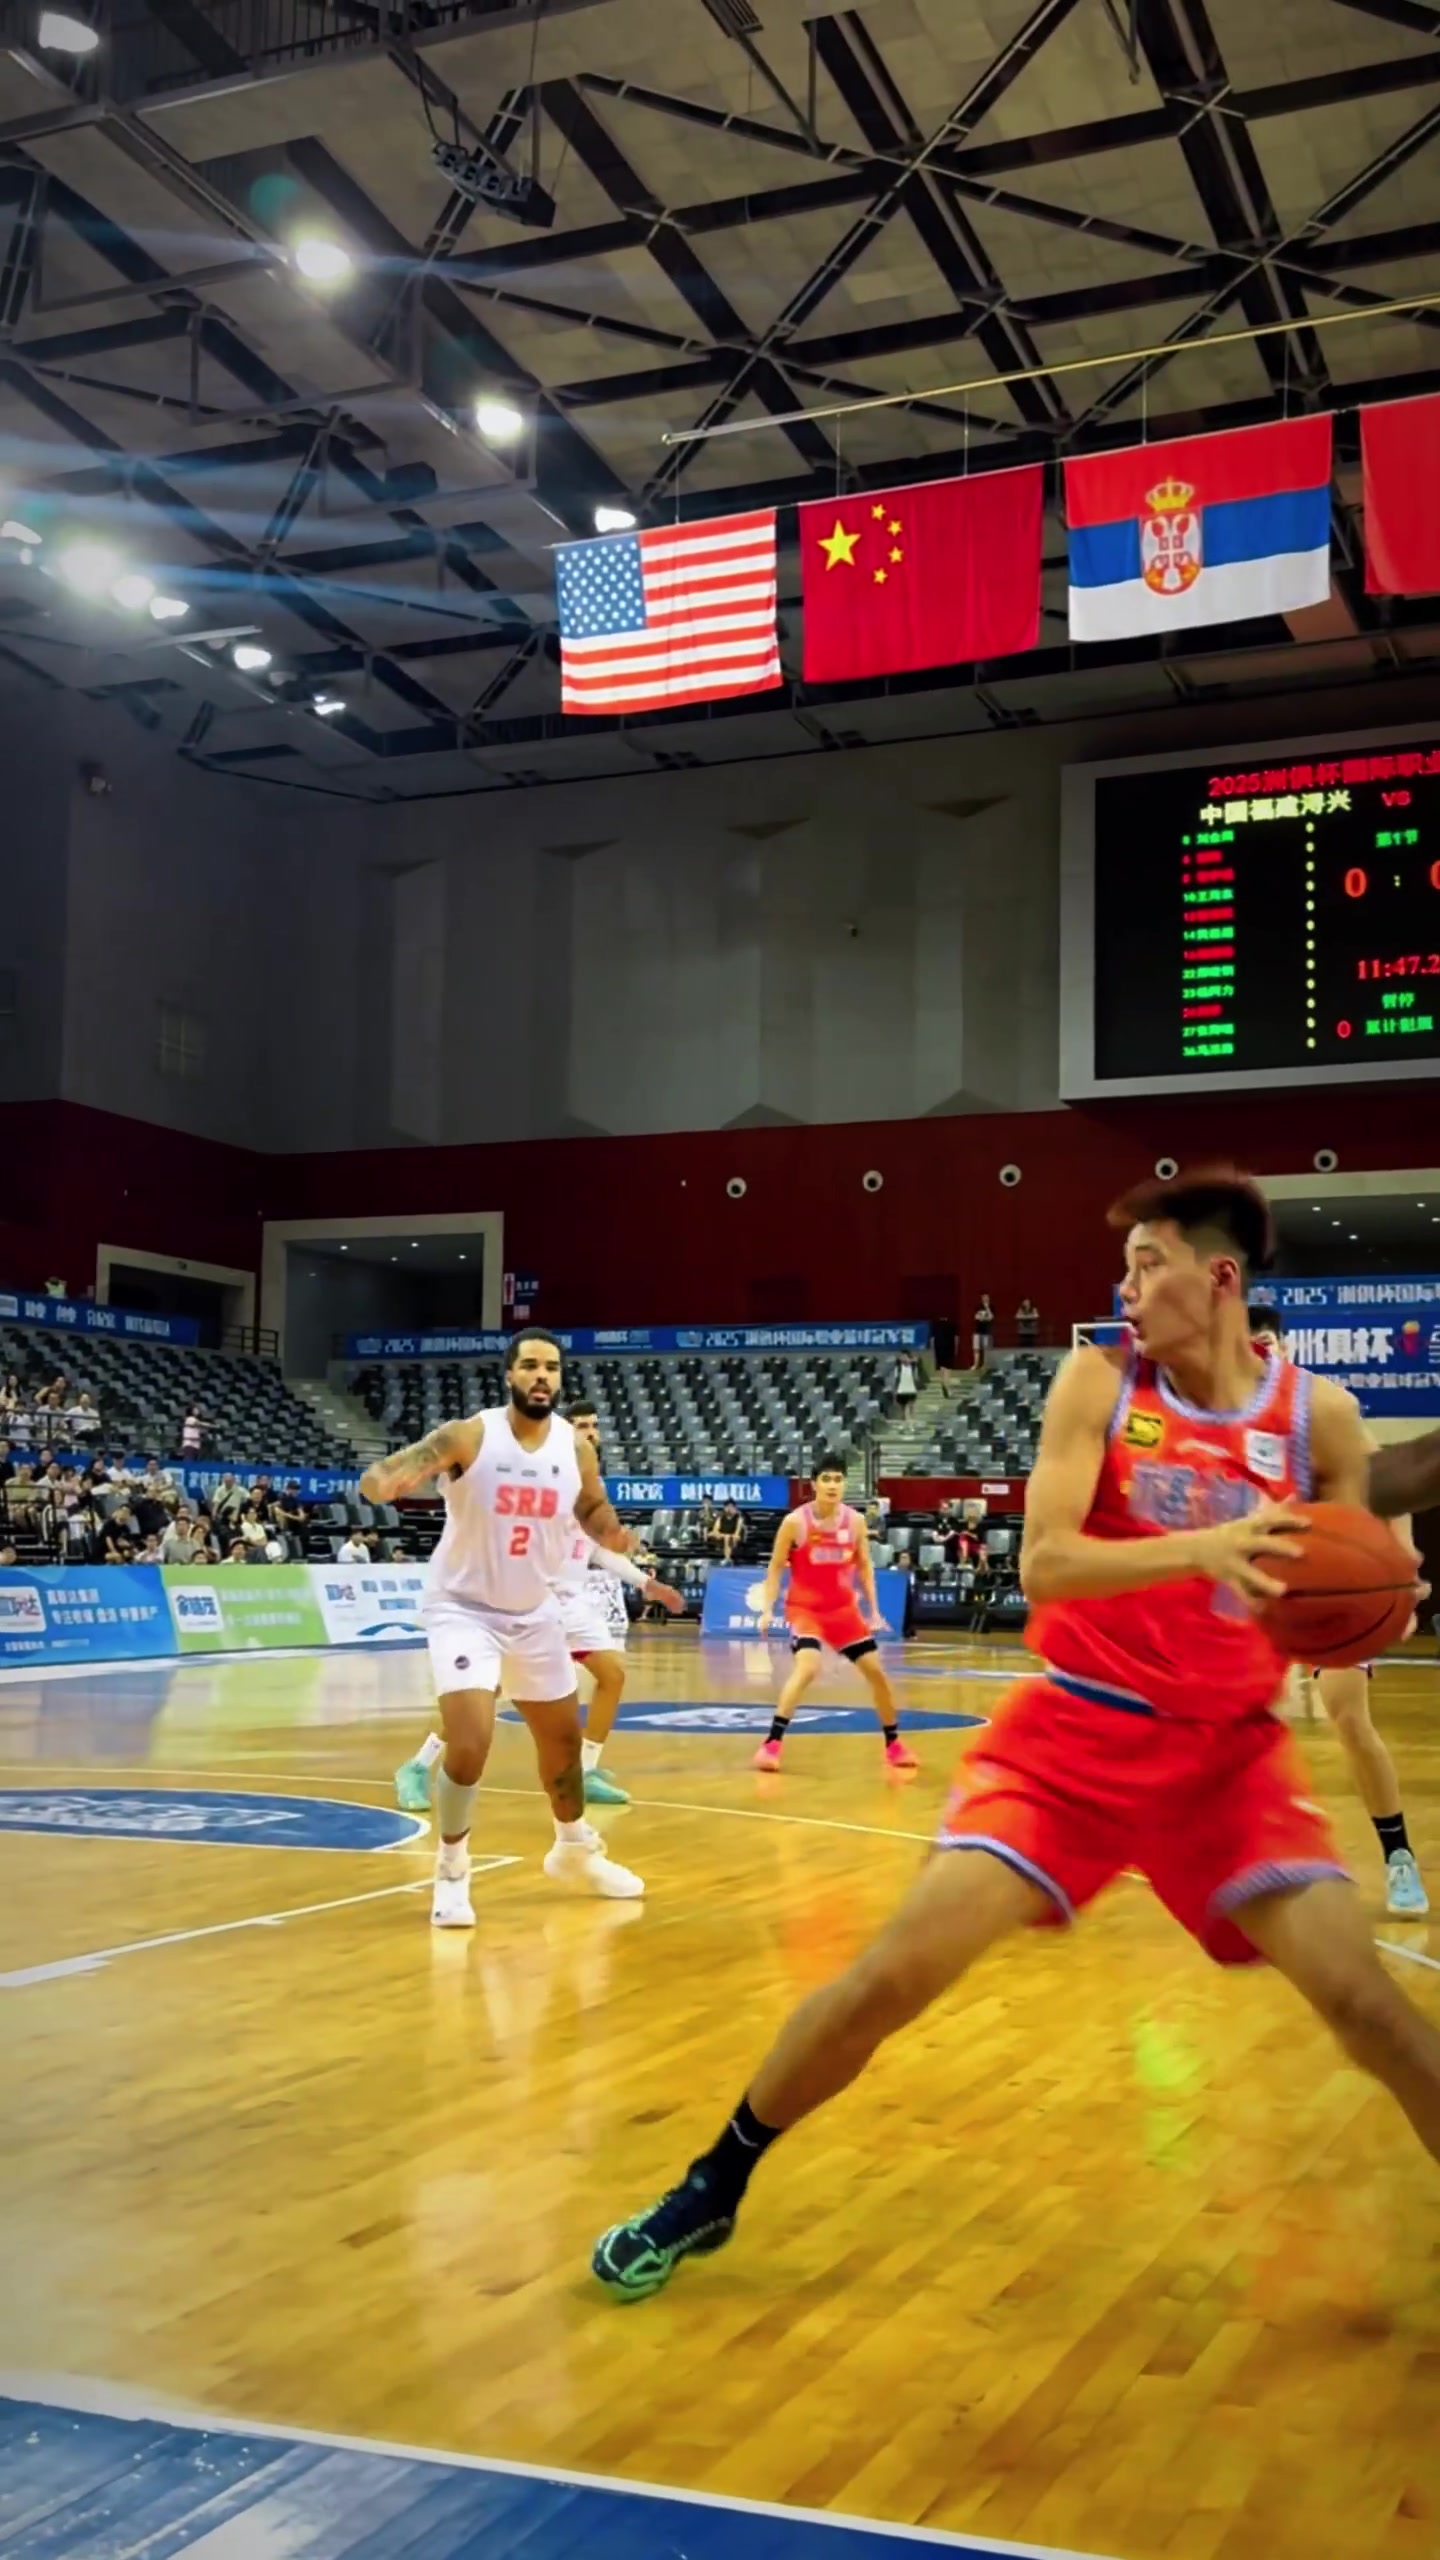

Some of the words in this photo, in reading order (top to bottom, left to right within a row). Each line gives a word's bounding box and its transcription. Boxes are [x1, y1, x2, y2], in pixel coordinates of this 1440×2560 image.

[1344, 867, 1367, 898] 0
[1358, 954, 1440, 980] 11:47.2
[1337, 1020, 1351, 1038] 0
[1283, 1287, 1328, 1305] 2025
[494, 1484, 559, 1521] SRB
[509, 1525, 531, 1557] 2
